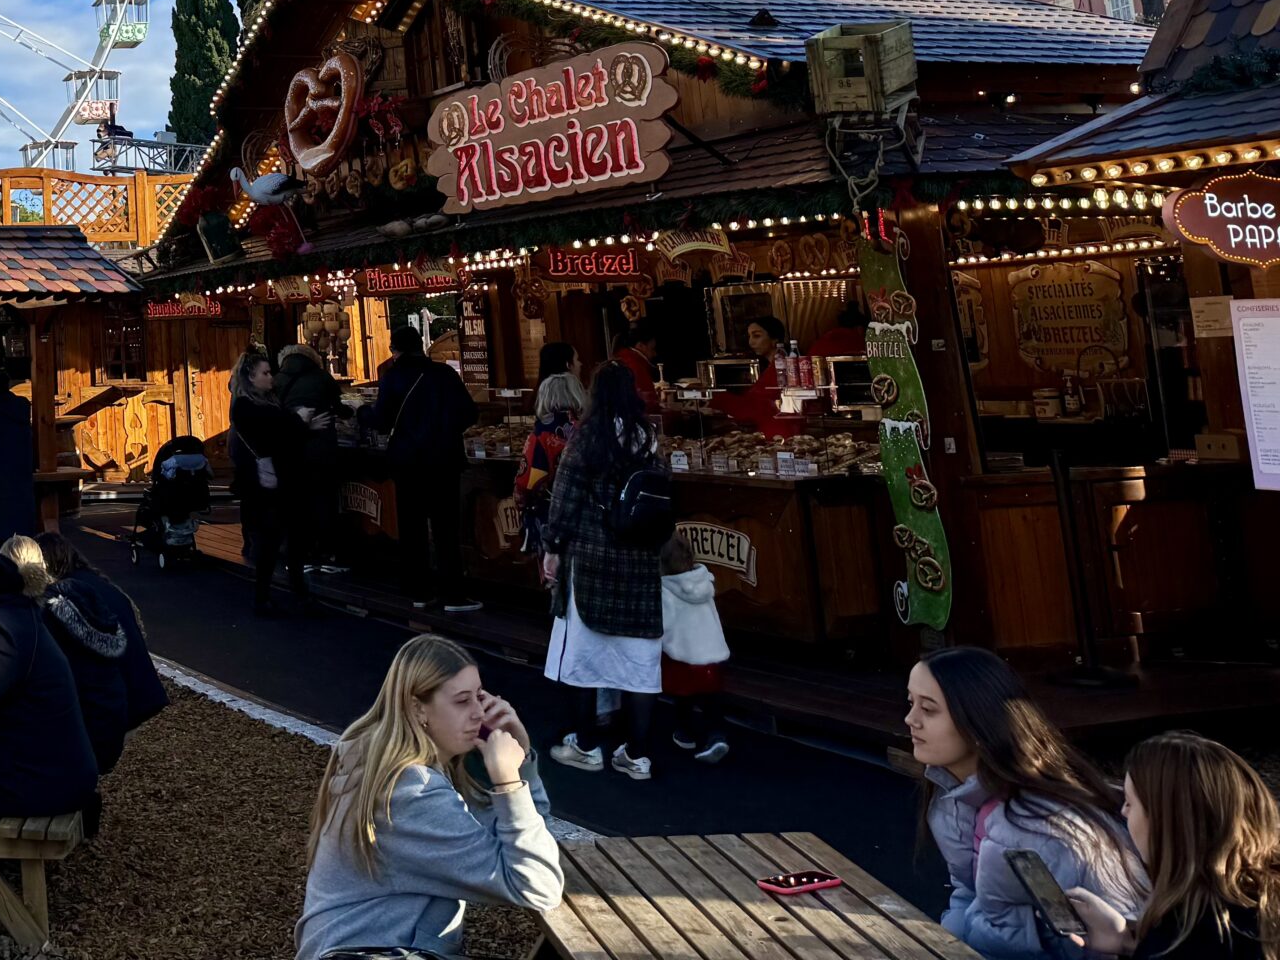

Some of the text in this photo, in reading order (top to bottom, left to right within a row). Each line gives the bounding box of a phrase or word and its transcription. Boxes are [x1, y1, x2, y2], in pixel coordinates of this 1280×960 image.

[468, 58, 609, 138] Le Chalet
[453, 117, 645, 206] Alsacien
[1204, 193, 1276, 219] Barbe
[1227, 224, 1280, 248] PAP
[548, 248, 641, 276] Bretzel
[1030, 302, 1103, 321] ALSACIENNES
[1236, 305, 1280, 313] CONFISERIES
[1043, 326, 1104, 343] BRETZELS
[866, 341, 905, 358] BRETZEL
